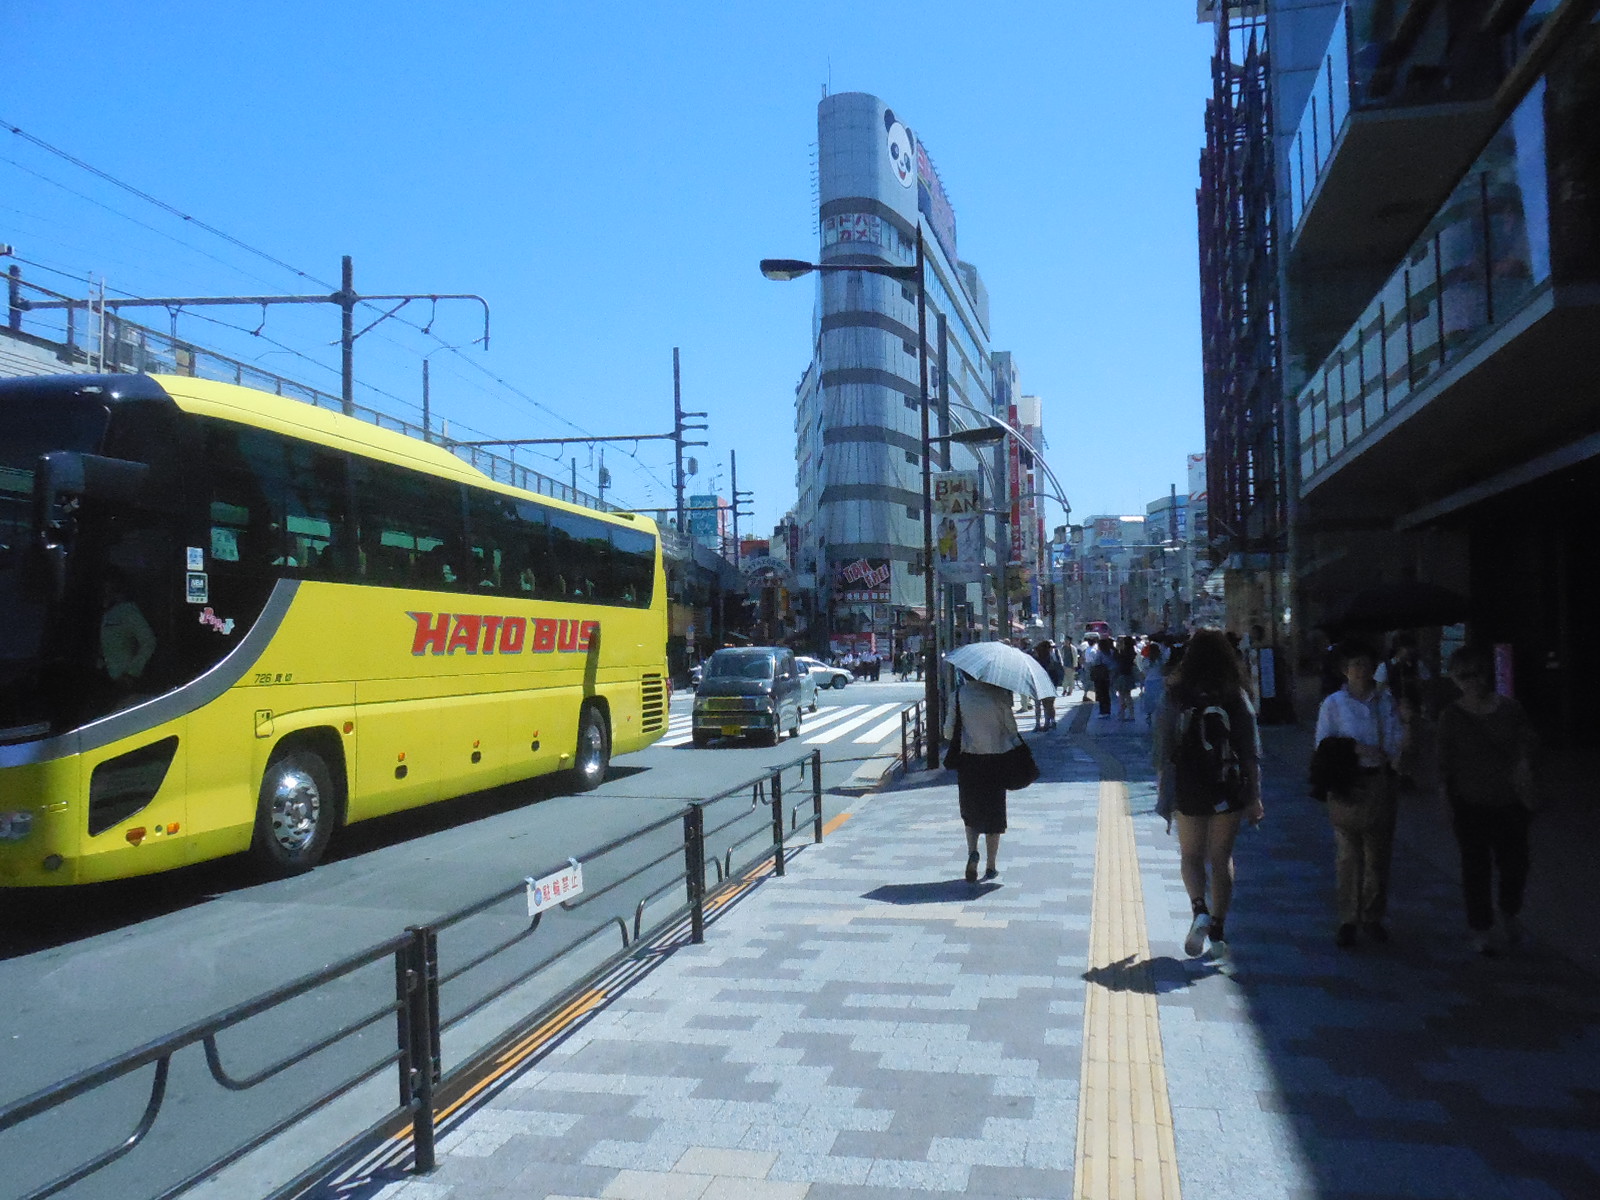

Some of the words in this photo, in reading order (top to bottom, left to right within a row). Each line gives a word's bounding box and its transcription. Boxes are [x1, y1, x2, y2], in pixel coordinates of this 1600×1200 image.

[405, 611, 527, 656] HATO
[531, 617, 601, 654] BUS
[254, 673, 272, 684] 726
